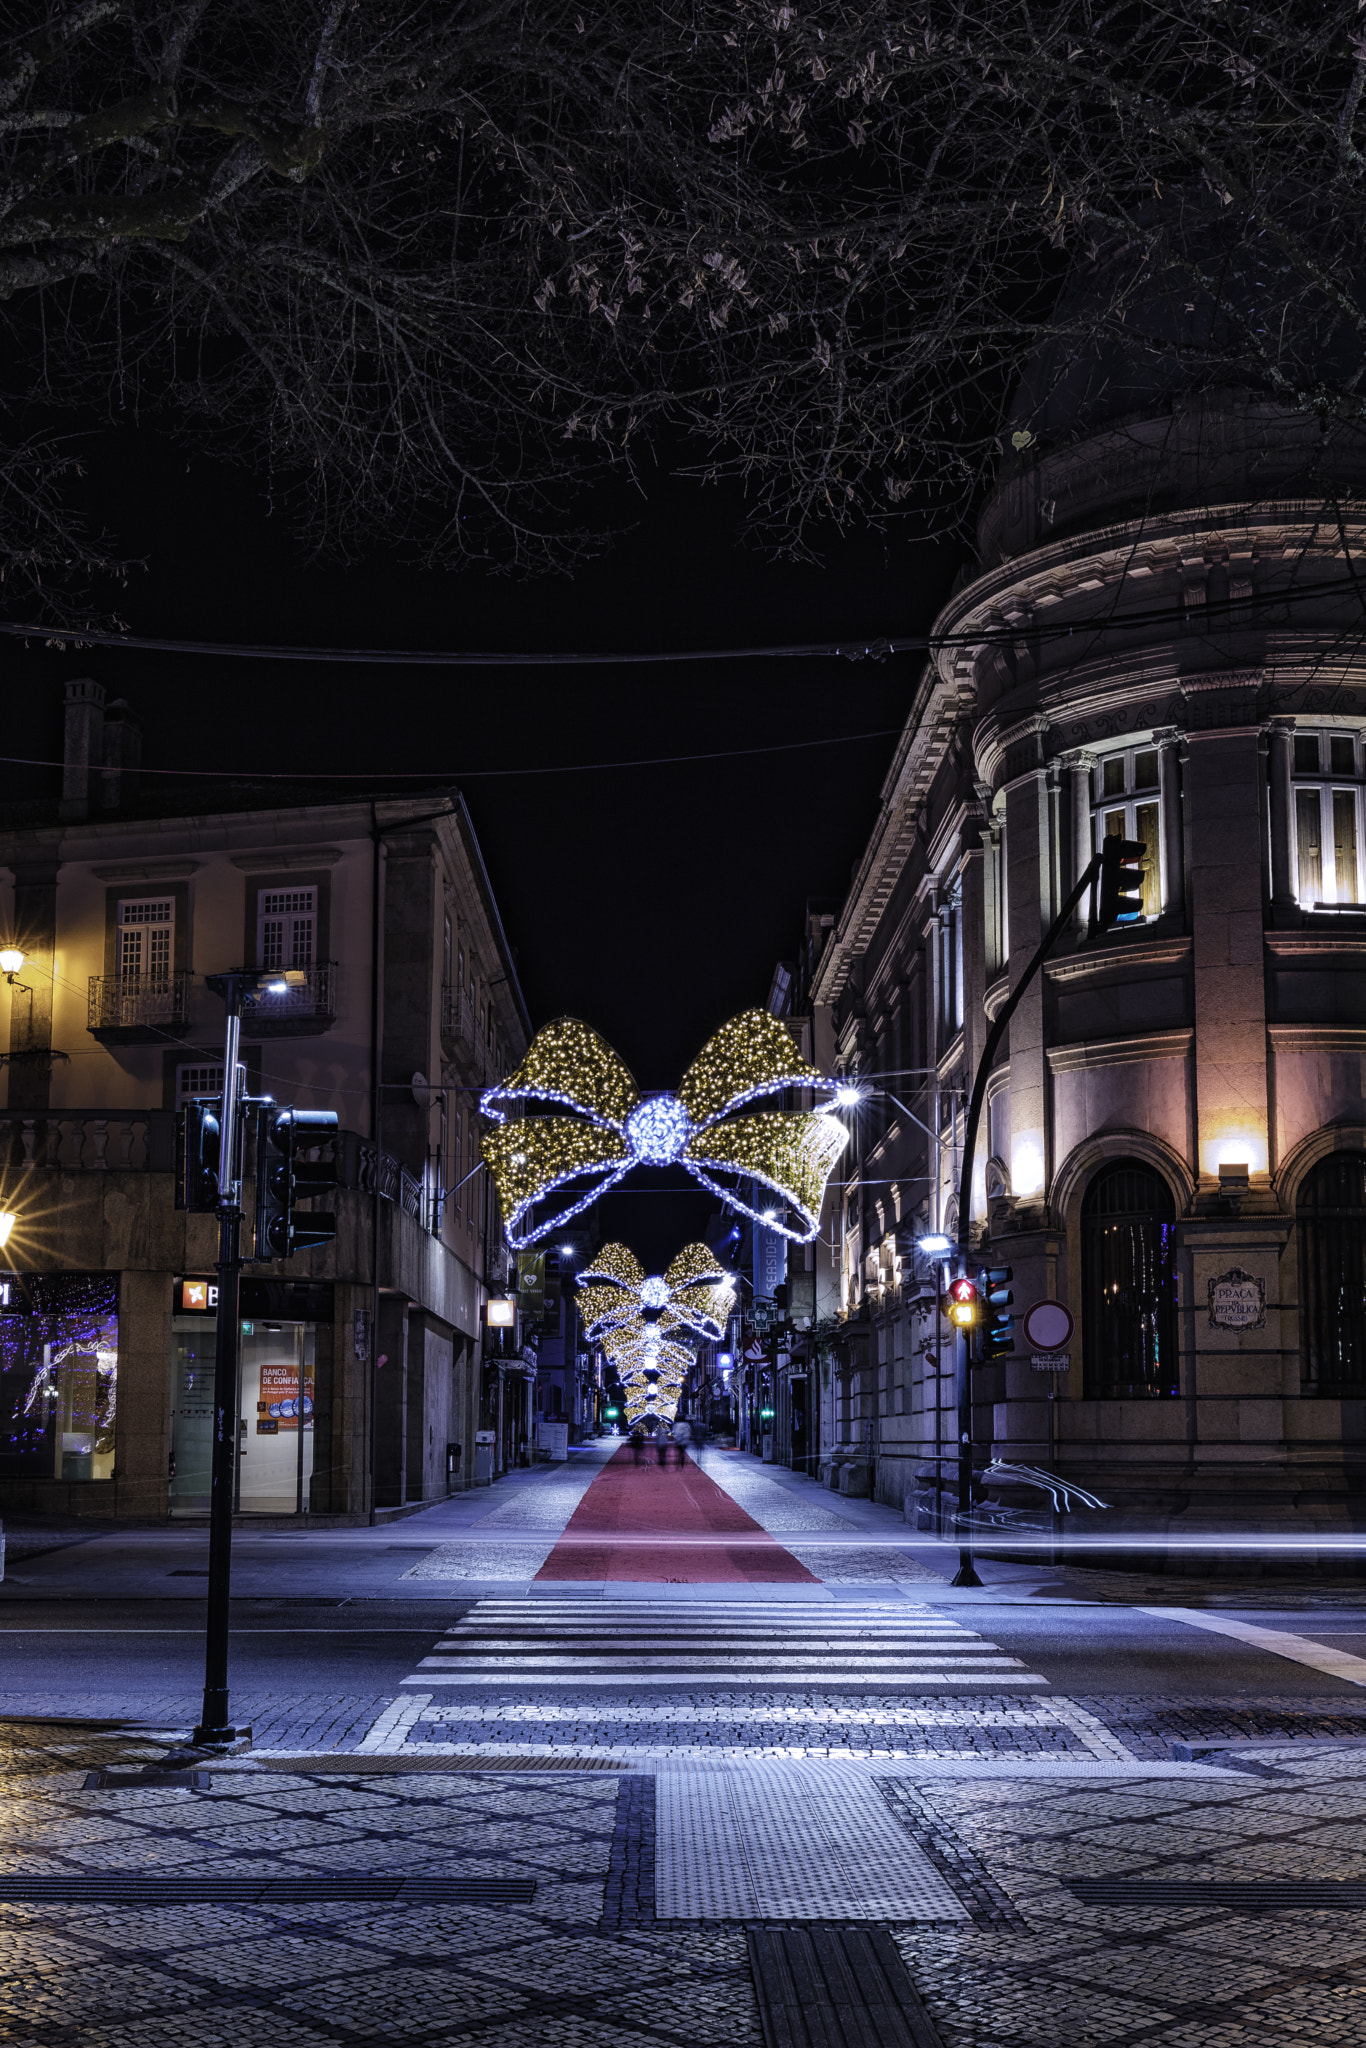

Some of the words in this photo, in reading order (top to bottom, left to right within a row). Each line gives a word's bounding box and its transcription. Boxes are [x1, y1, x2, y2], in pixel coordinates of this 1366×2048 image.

[766, 1238, 777, 1290] SEASIDE
[1219, 1289, 1253, 1299] PRAÇA
[263, 1368, 287, 1376] BANCO
[262, 1377, 272, 1385] DE
[273, 1377, 315, 1387] CONFIAÇA.
